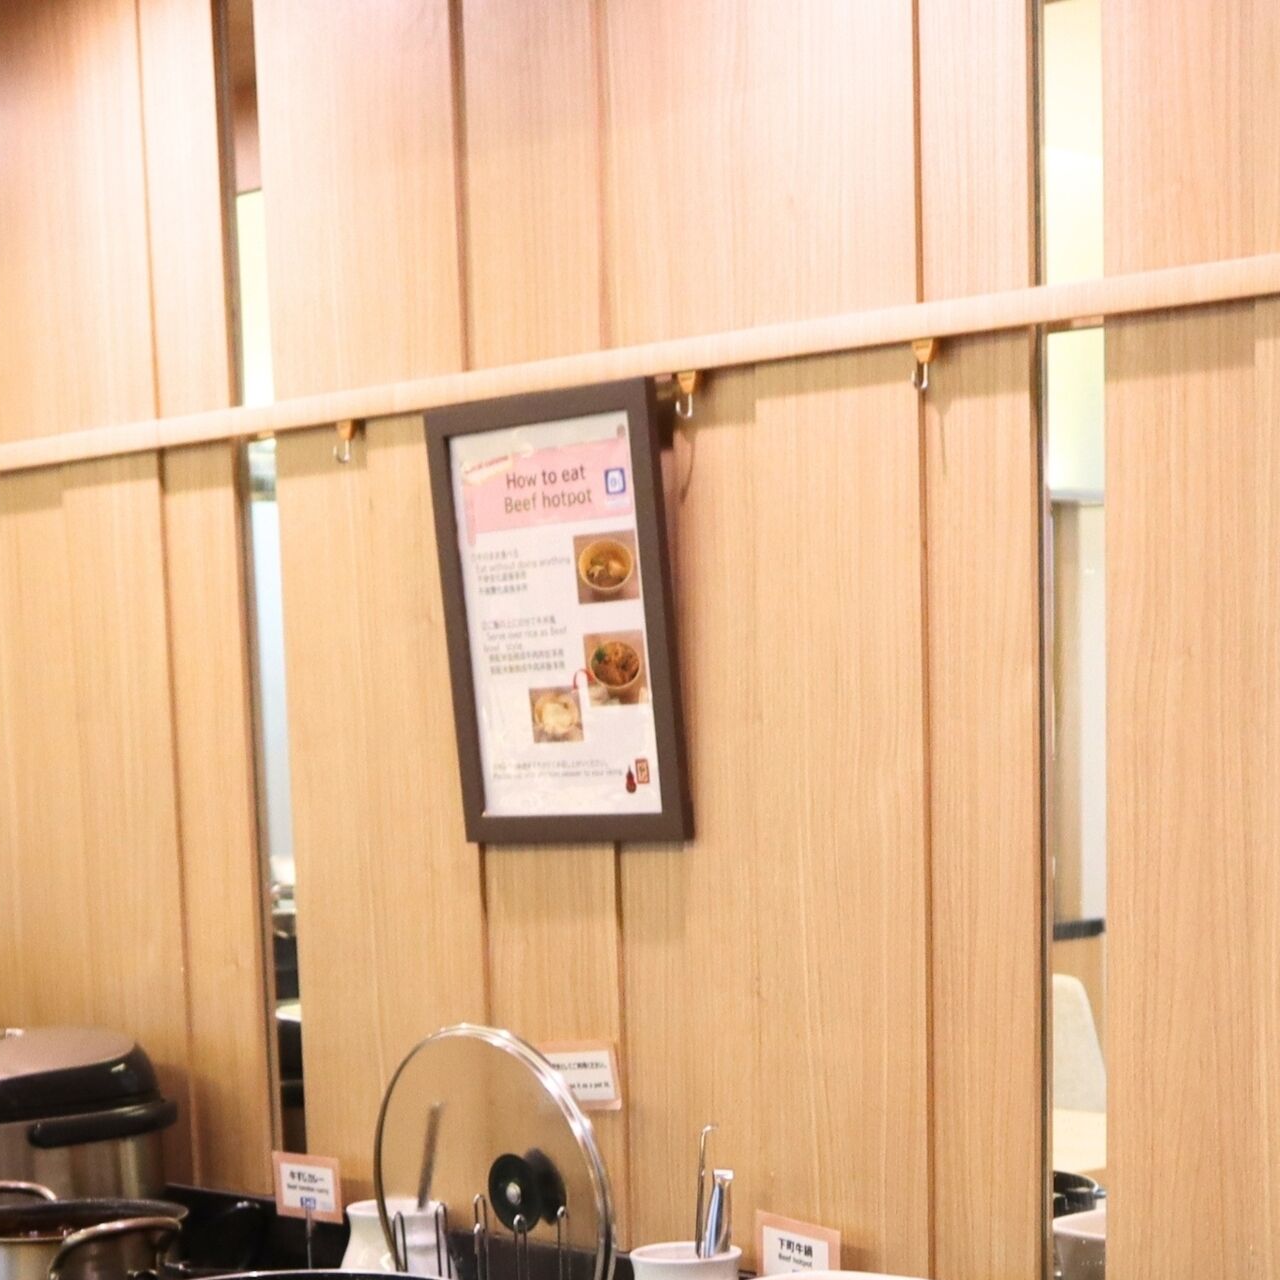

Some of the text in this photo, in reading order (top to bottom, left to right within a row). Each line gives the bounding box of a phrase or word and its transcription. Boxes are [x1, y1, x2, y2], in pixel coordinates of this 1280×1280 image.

[506, 464, 587, 490] How to eat
[504, 488, 593, 515] Beef hotpot
